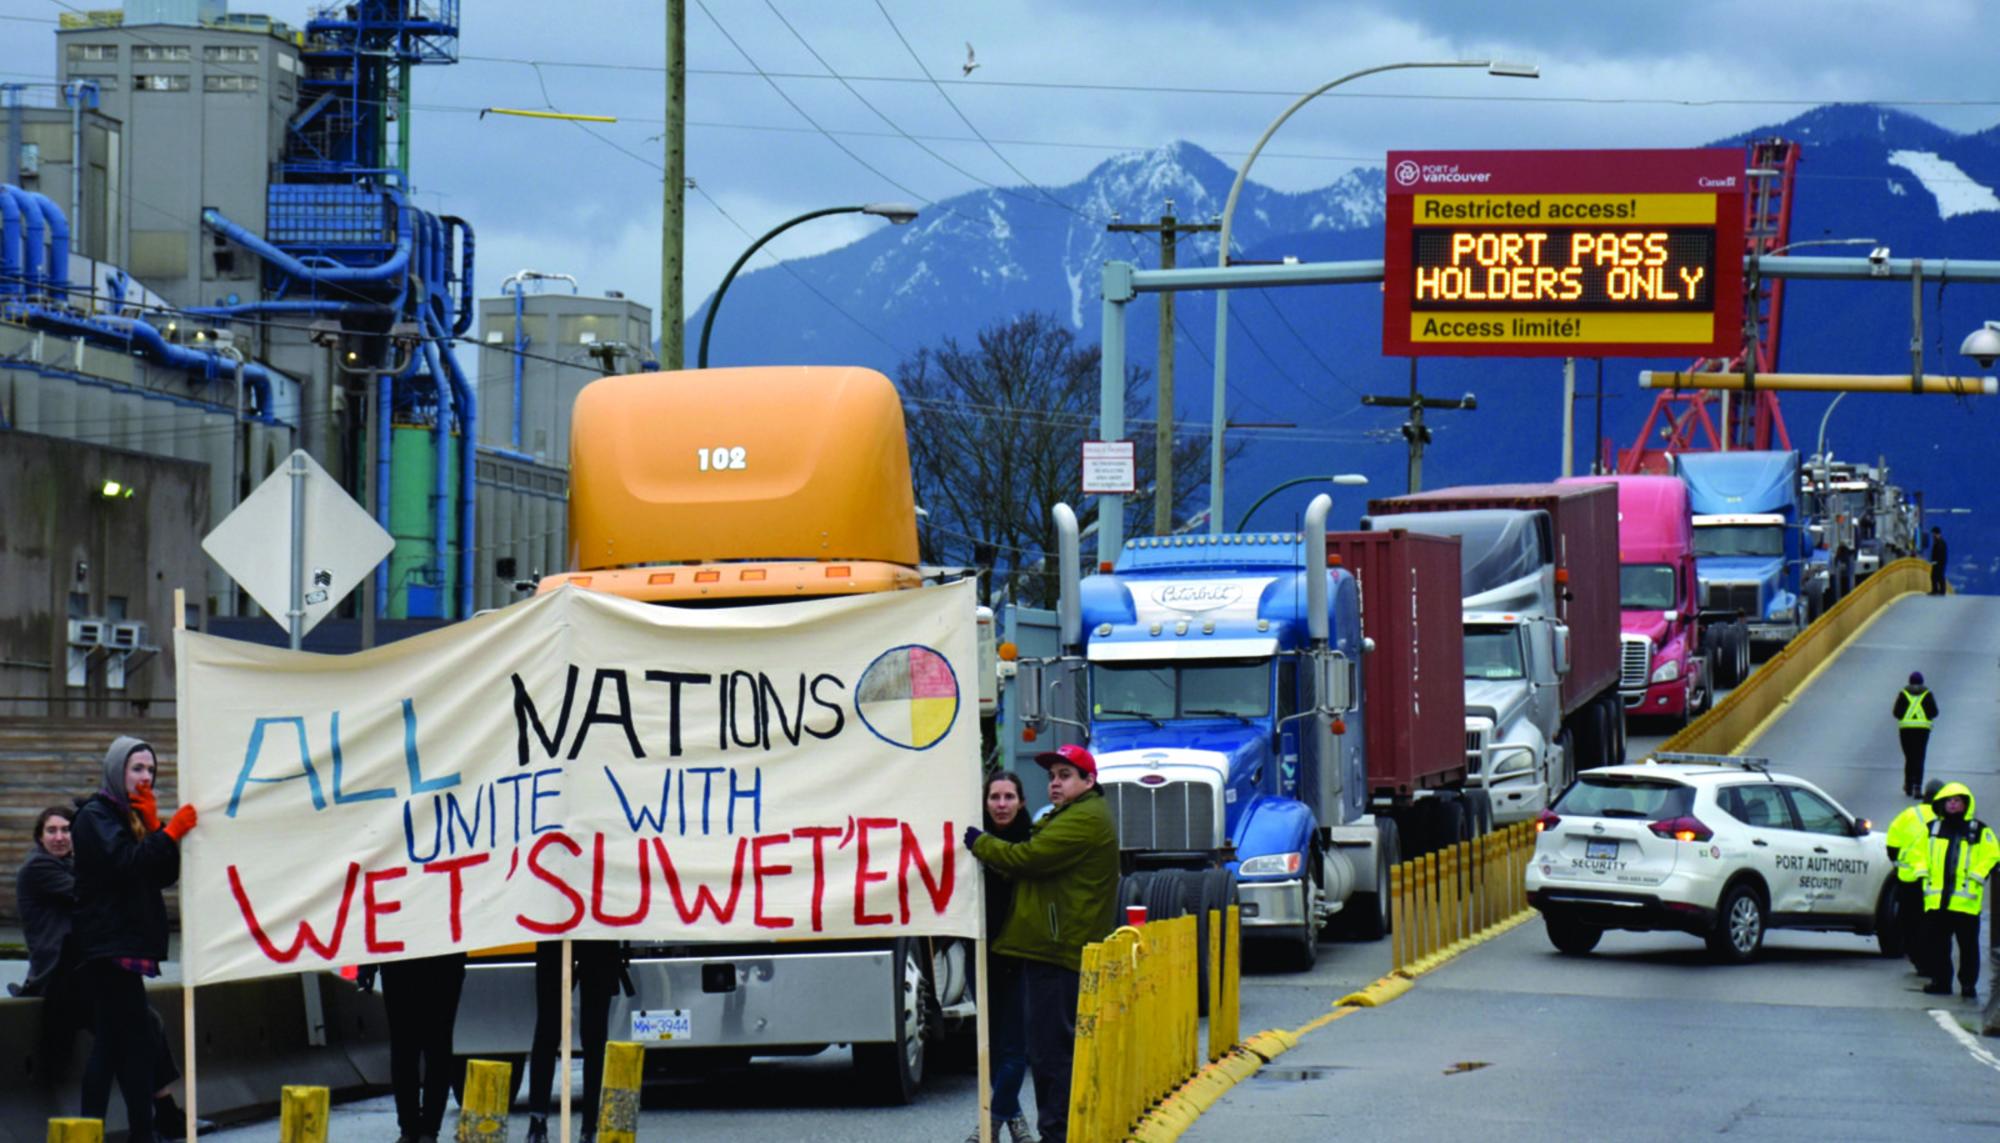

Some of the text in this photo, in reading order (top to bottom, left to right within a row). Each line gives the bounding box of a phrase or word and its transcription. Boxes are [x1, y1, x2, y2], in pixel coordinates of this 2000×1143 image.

[1422, 164, 1448, 173] PORT
[1423, 172, 1491, 182] vancouver
[1424, 199, 1636, 218] Restricted access!
[1452, 233, 1668, 266] PORT PASS
[1416, 266, 1704, 300] HOLDERS ONLY
[1423, 317, 1580, 337] Access limité!
[698, 446, 746, 471] 102
[226, 664, 846, 819] ALL NATIONS
[403, 766, 762, 864] UNITE WITH
[1571, 859, 1627, 870] SECURITY
[1775, 854, 1869, 874] PORT AUTHORITY
[227, 815, 955, 964] WET'SUWET'EN
[1799, 876, 1842, 889] SECURITY
